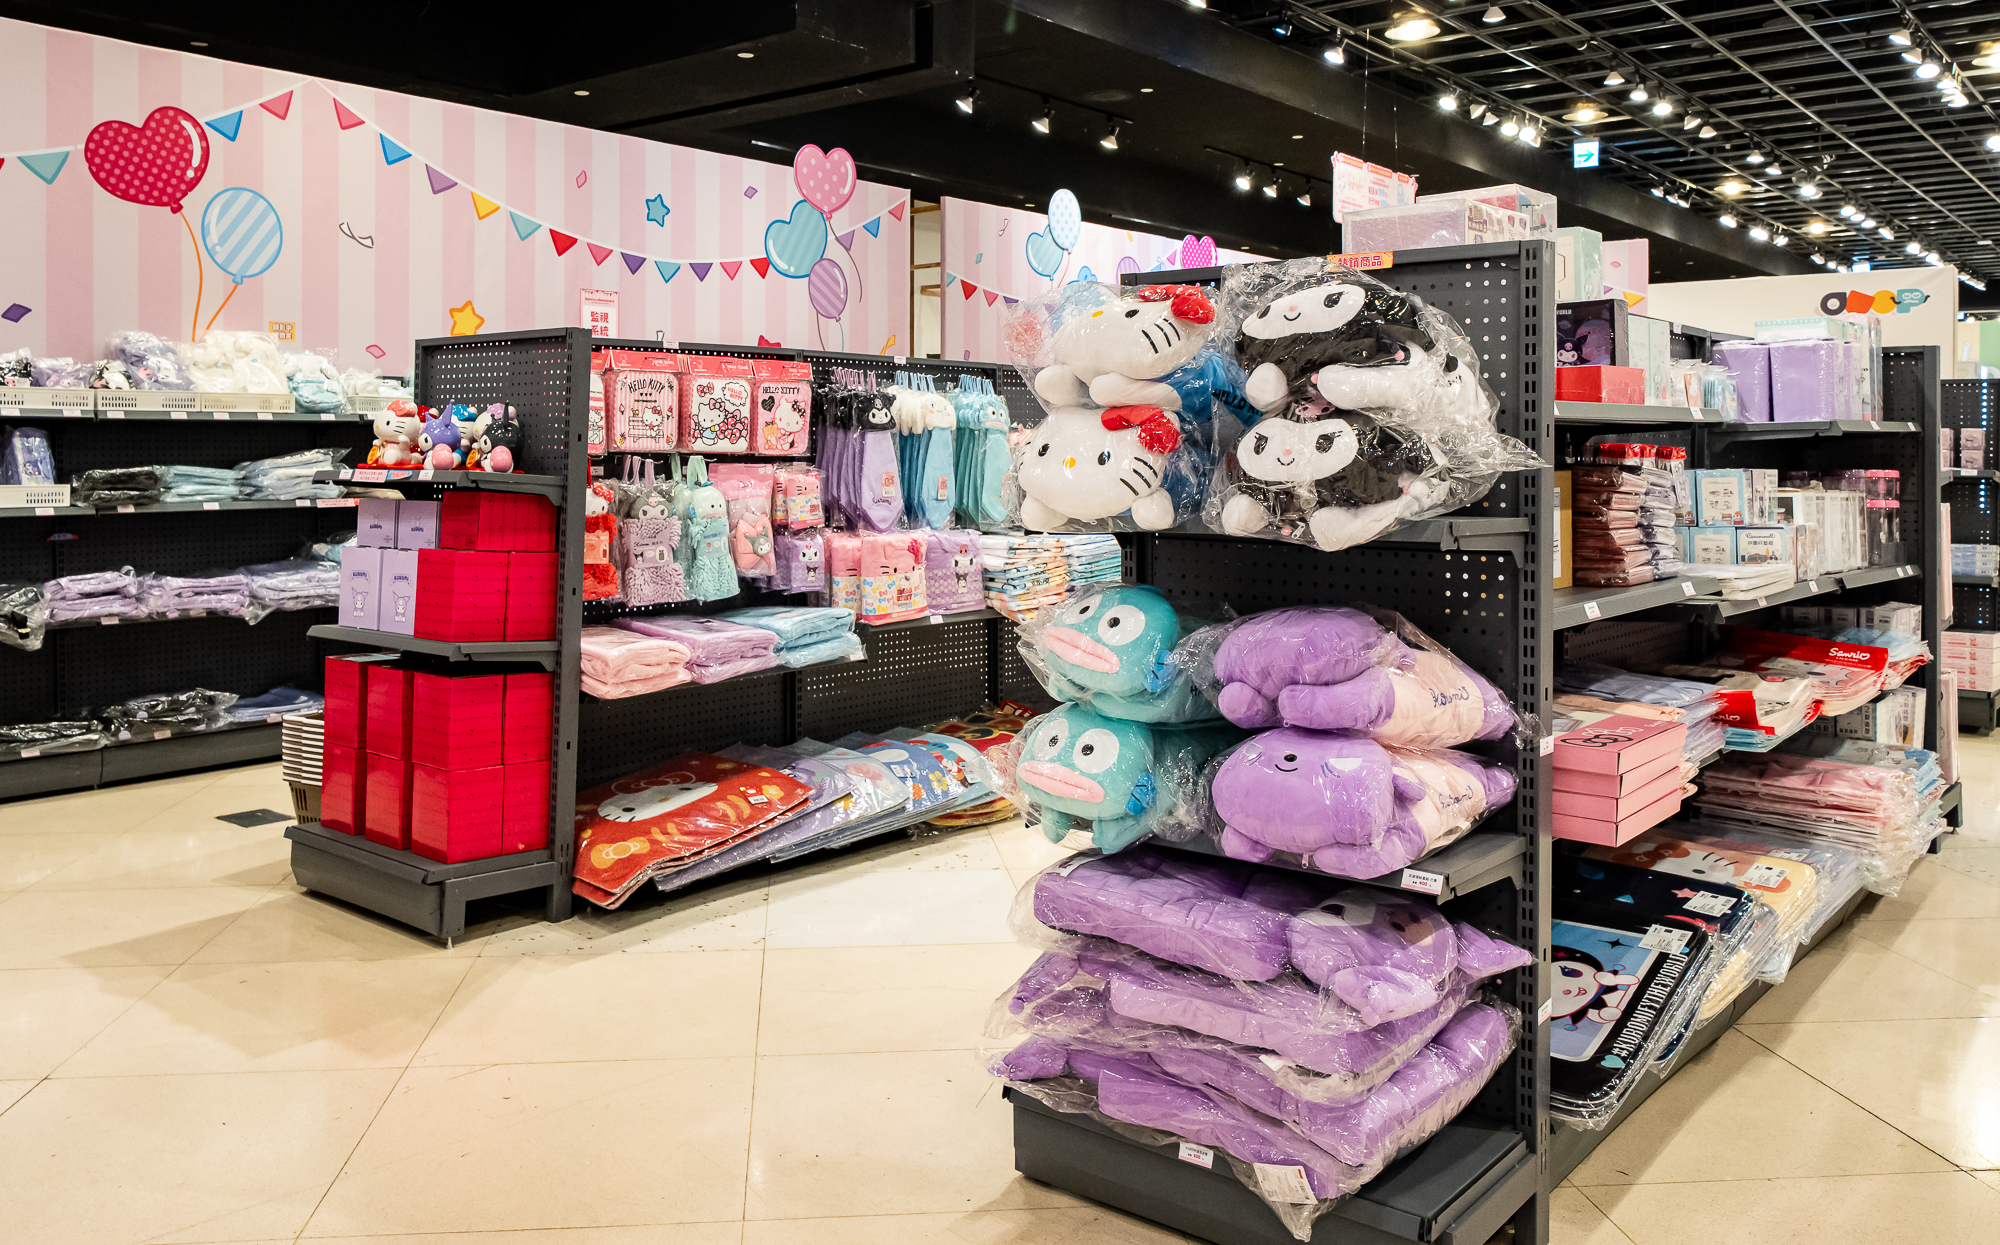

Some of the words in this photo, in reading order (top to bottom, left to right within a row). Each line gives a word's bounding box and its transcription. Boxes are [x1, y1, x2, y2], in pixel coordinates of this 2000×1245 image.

[1338, 255, 1382, 268] 熱銷商品
[591, 311, 609, 324] 監視
[591, 324, 609, 337] 系統
[627, 378, 647, 394] HELLO
[648, 378, 666, 394] KITTY
[727, 386, 743, 396] HELLO
[762, 386, 780, 394] HELLO
[780, 386, 801, 395] KITTY
[729, 393, 744, 401] KITTY
[1611, 953, 1689, 1057] #KUROMIFYTHEWORLD
